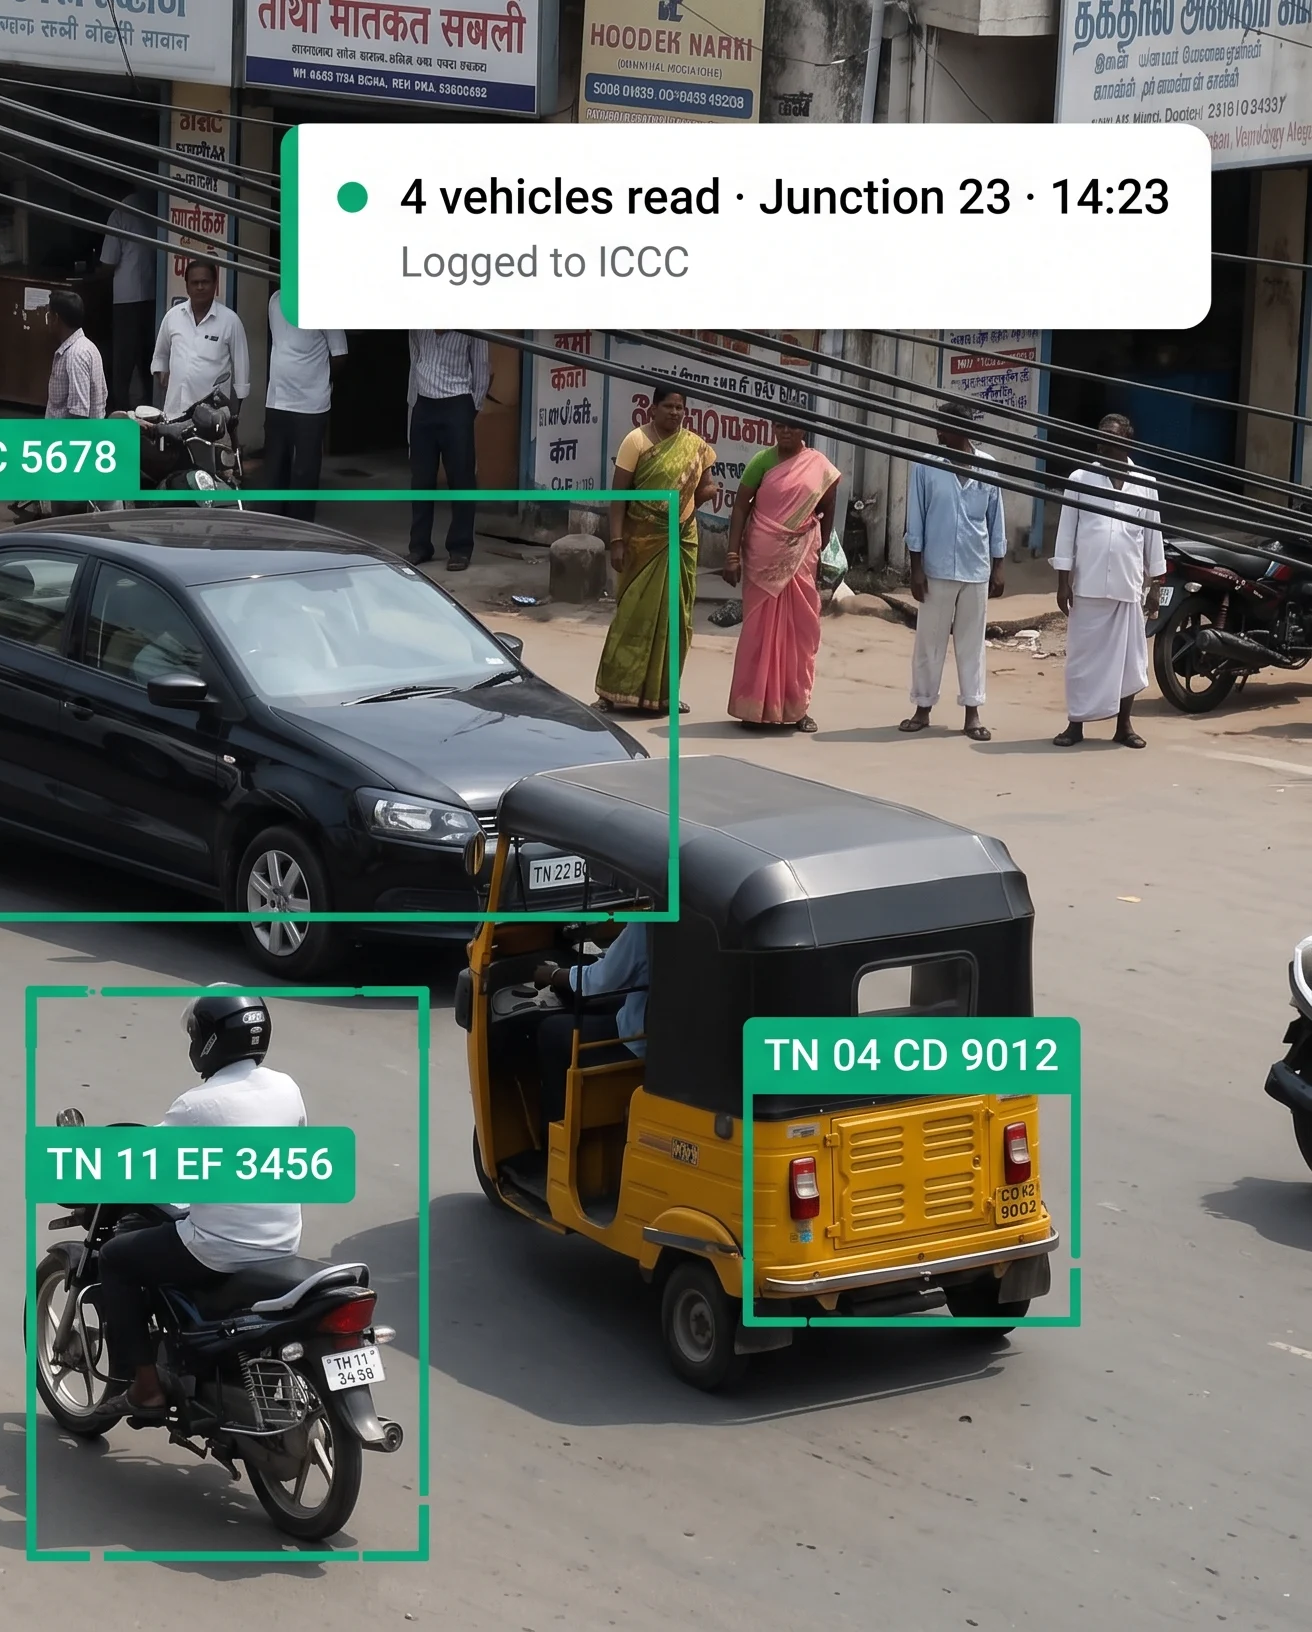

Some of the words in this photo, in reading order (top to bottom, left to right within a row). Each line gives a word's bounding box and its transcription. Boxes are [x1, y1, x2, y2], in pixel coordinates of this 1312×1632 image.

[590, 23, 682, 55] HOODEK
[534, 865, 551, 883] TN
[554, 863, 571, 881] 22
[1001, 1200, 1037, 1219] 9002
[354, 1353, 368, 1366] 11
